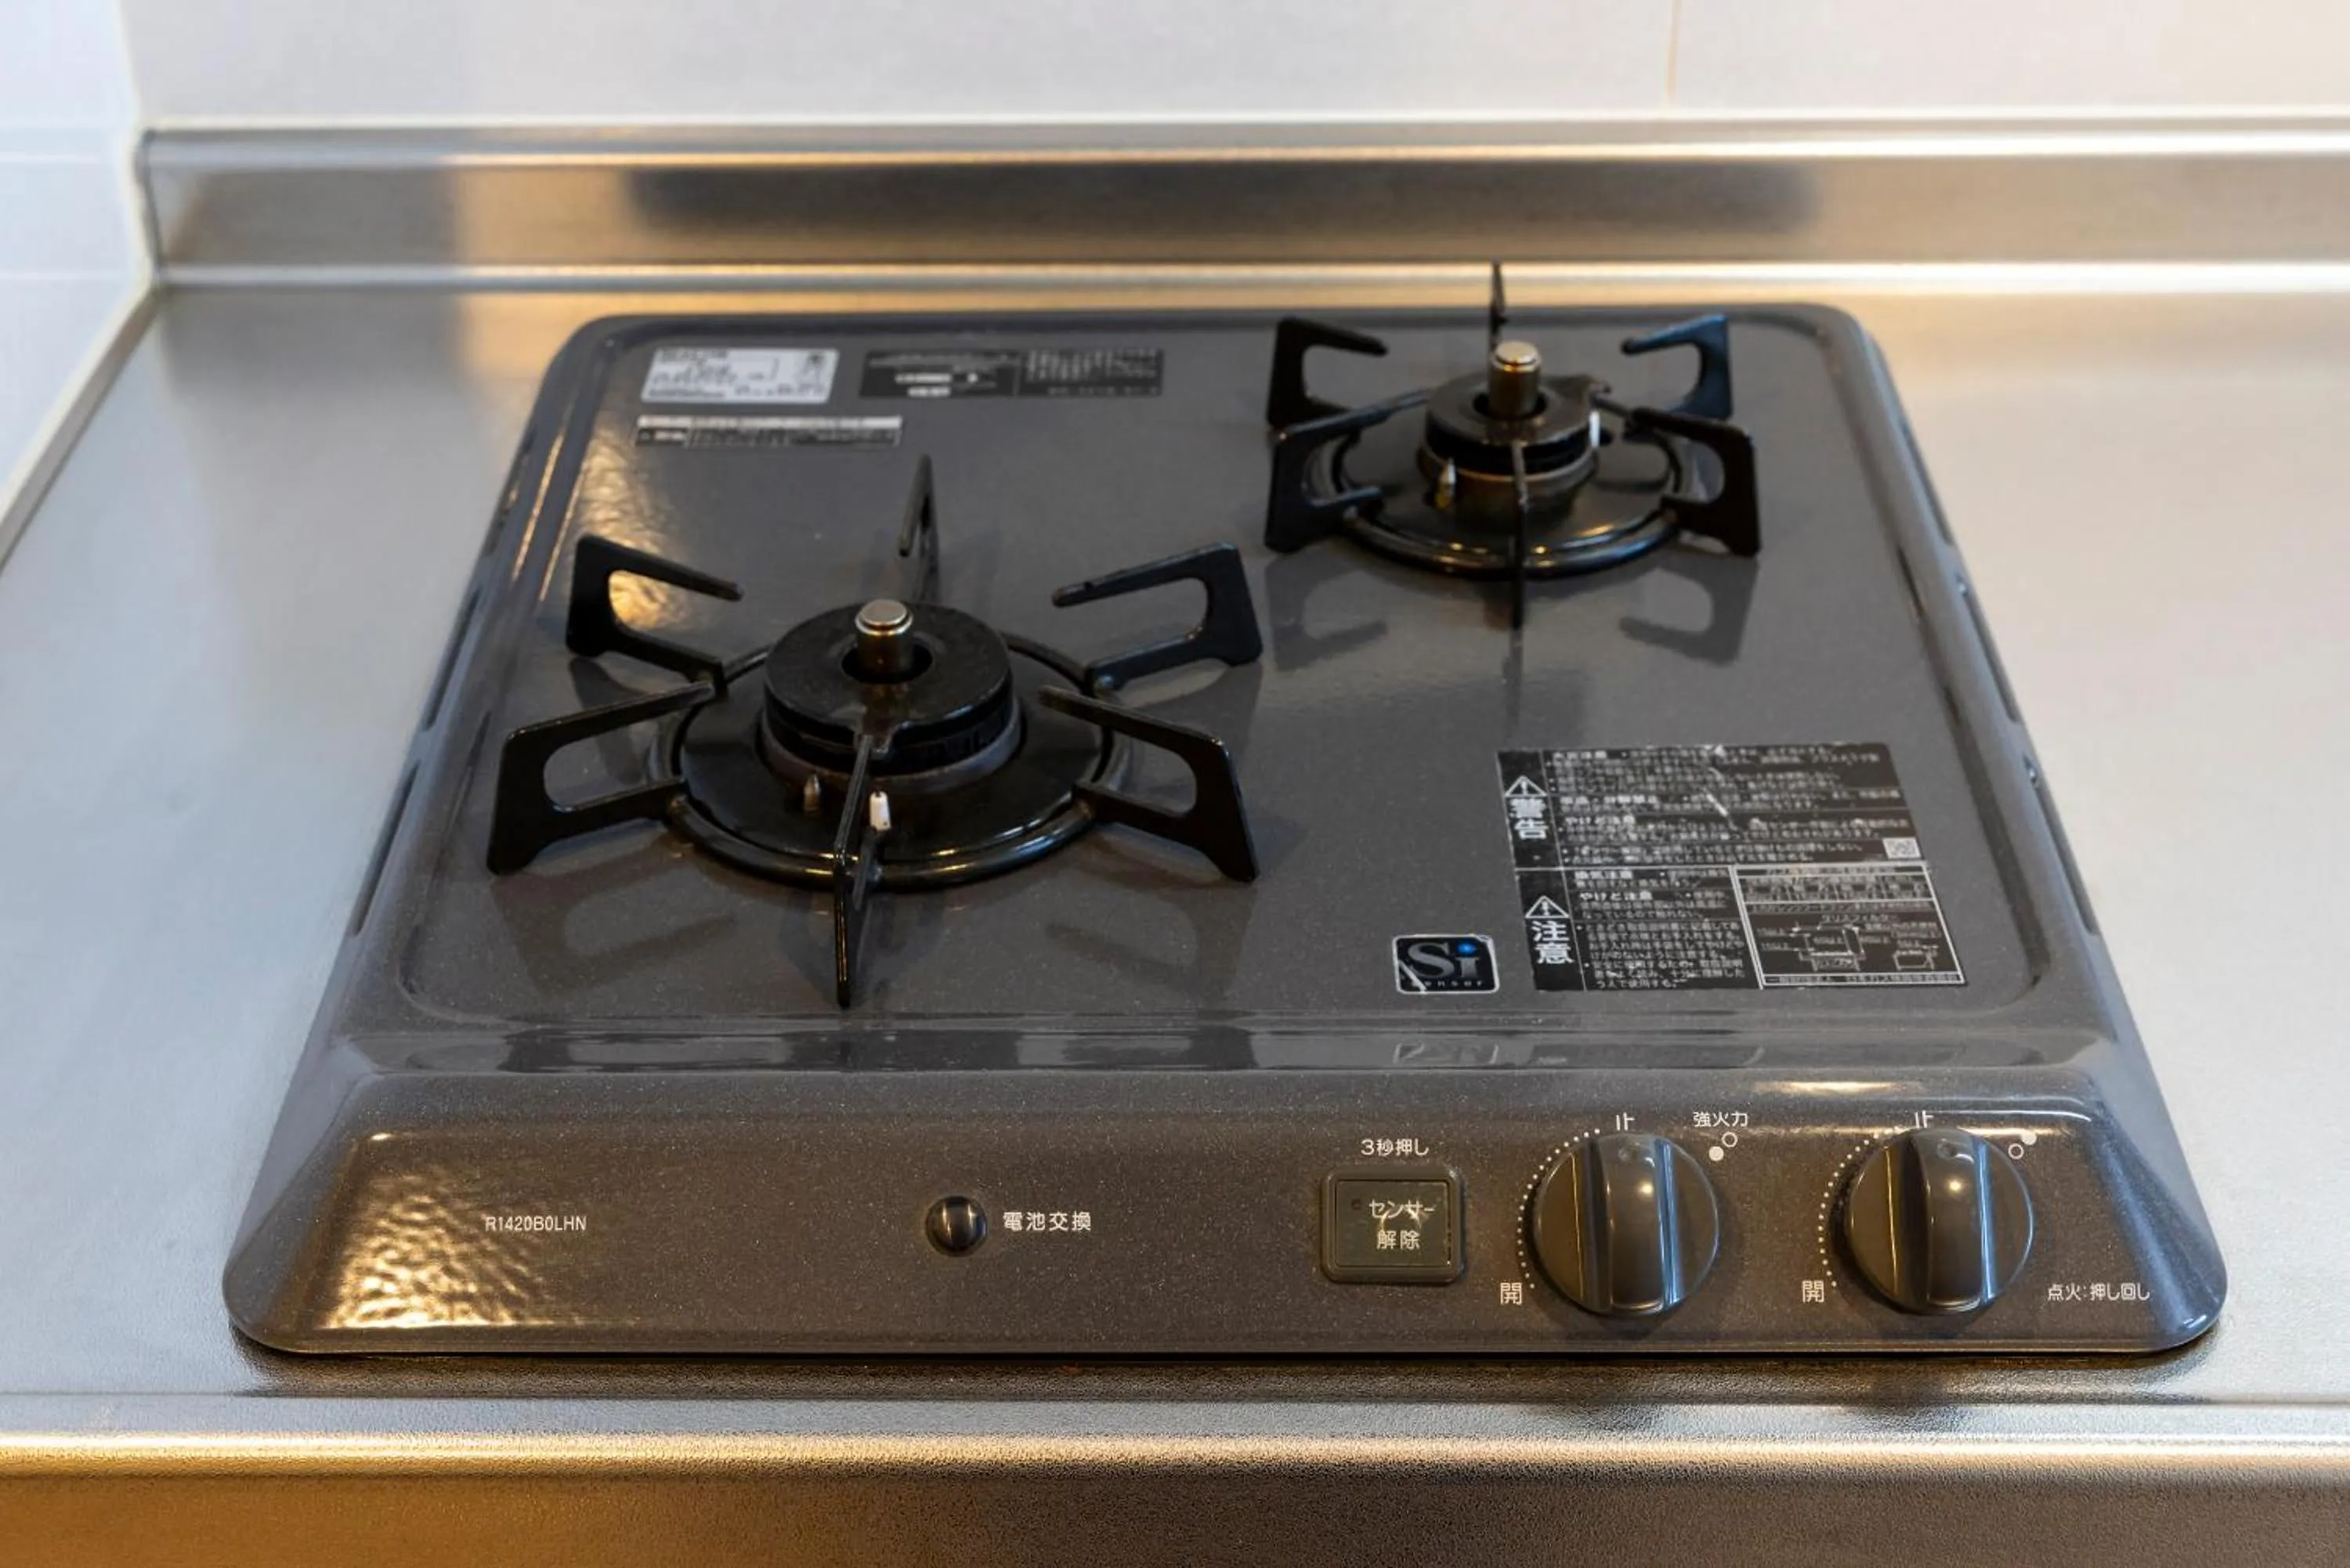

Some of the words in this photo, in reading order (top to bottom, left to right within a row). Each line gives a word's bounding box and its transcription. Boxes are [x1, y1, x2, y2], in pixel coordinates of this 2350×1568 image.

[1531, 920, 1574, 964] 注意
[1693, 1111, 1749, 1128] 強火力
[1361, 1138, 1430, 1157] 3秒押し
[1368, 1198, 1436, 1219] センサー
[1003, 1211, 1091, 1232] 電池交換
[1376, 1230, 1420, 1250] 解除
[1500, 1282, 1522, 1306] 開
[1802, 1280, 1824, 1303] 開
